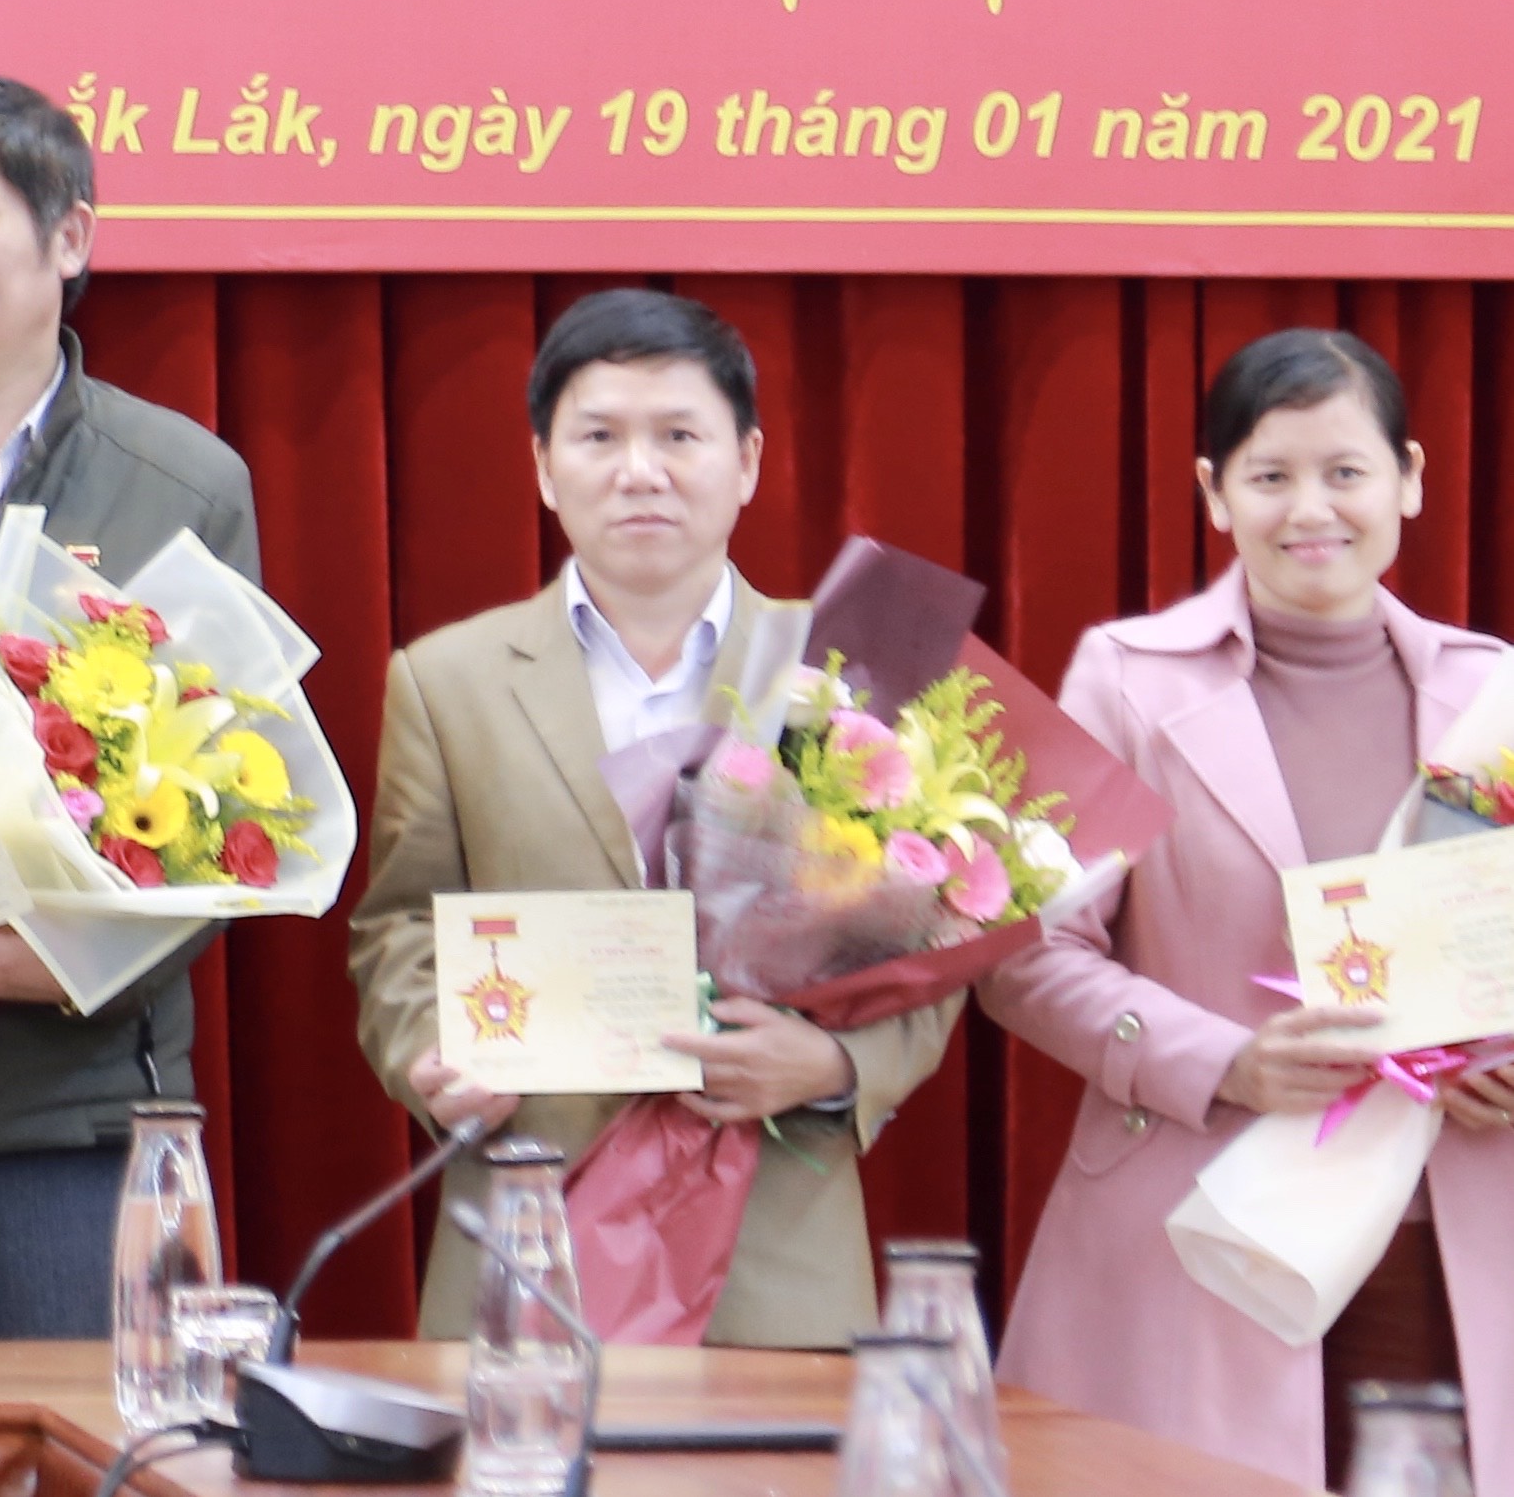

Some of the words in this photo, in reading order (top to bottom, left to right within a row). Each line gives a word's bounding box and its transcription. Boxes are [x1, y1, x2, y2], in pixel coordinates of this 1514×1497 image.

[64, 71, 149, 153] ắk
[172, 72, 337, 167] Lắk,
[368, 87, 573, 174] ngày
[600, 89, 689, 156] 19
[715, 89, 947, 175] tháng
[972, 91, 1062, 157] 01
[1091, 91, 1267, 160] năm
[1296, 94, 1481, 162] 2021
